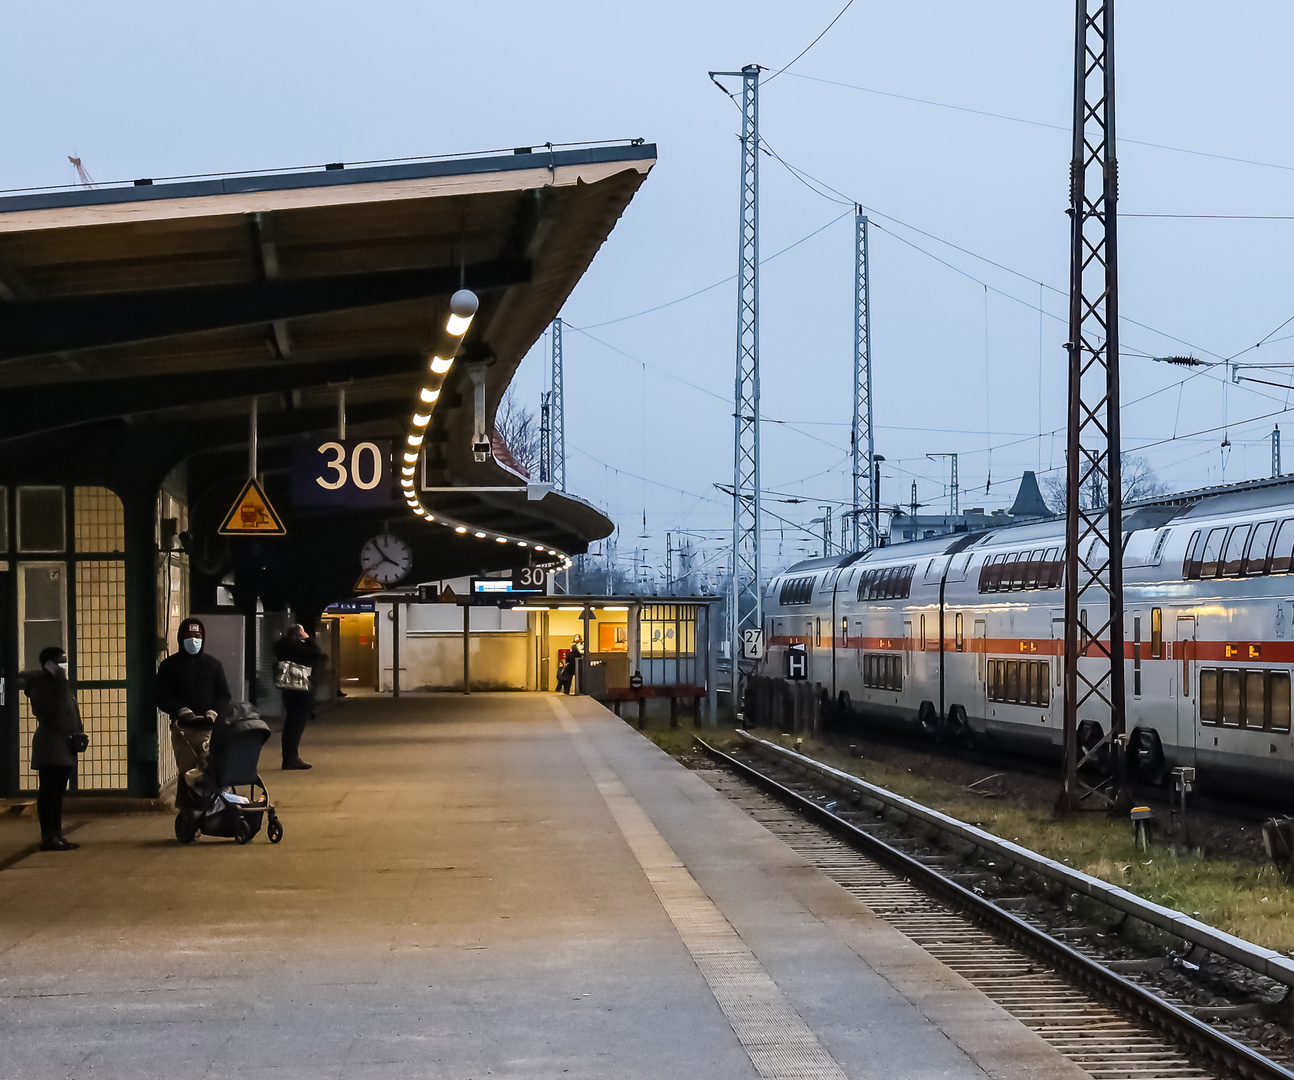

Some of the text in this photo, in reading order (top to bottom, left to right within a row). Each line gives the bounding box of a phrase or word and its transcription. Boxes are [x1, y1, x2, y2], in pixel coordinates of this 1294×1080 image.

[316, 441, 382, 490] 30
[520, 567, 544, 585] 30
[745, 630, 761, 643] 27
[750, 644, 758, 656] 4
[789, 655, 805, 676] H
